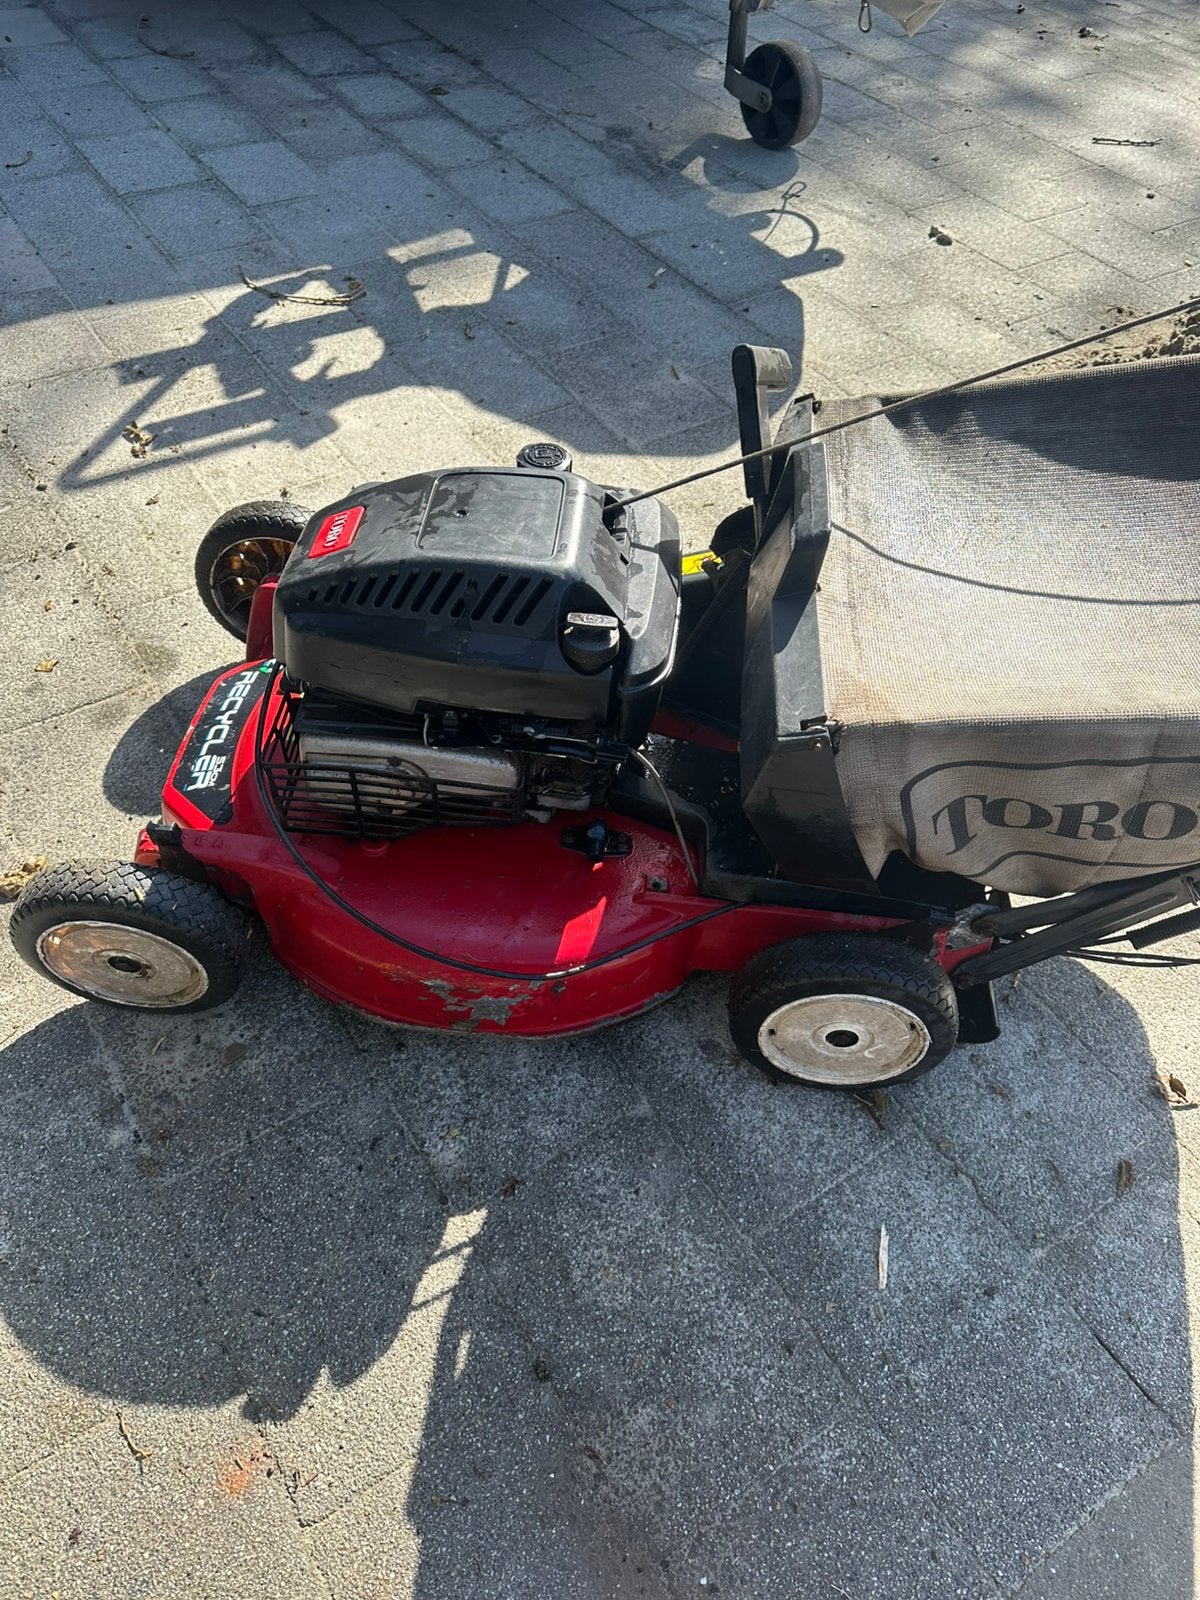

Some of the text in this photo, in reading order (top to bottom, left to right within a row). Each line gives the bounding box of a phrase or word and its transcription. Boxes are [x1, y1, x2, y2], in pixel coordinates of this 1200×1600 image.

[322, 511, 350, 547] TORO
[183, 671, 260, 792] RECYCLER
[932, 795, 1198, 855] TORO
